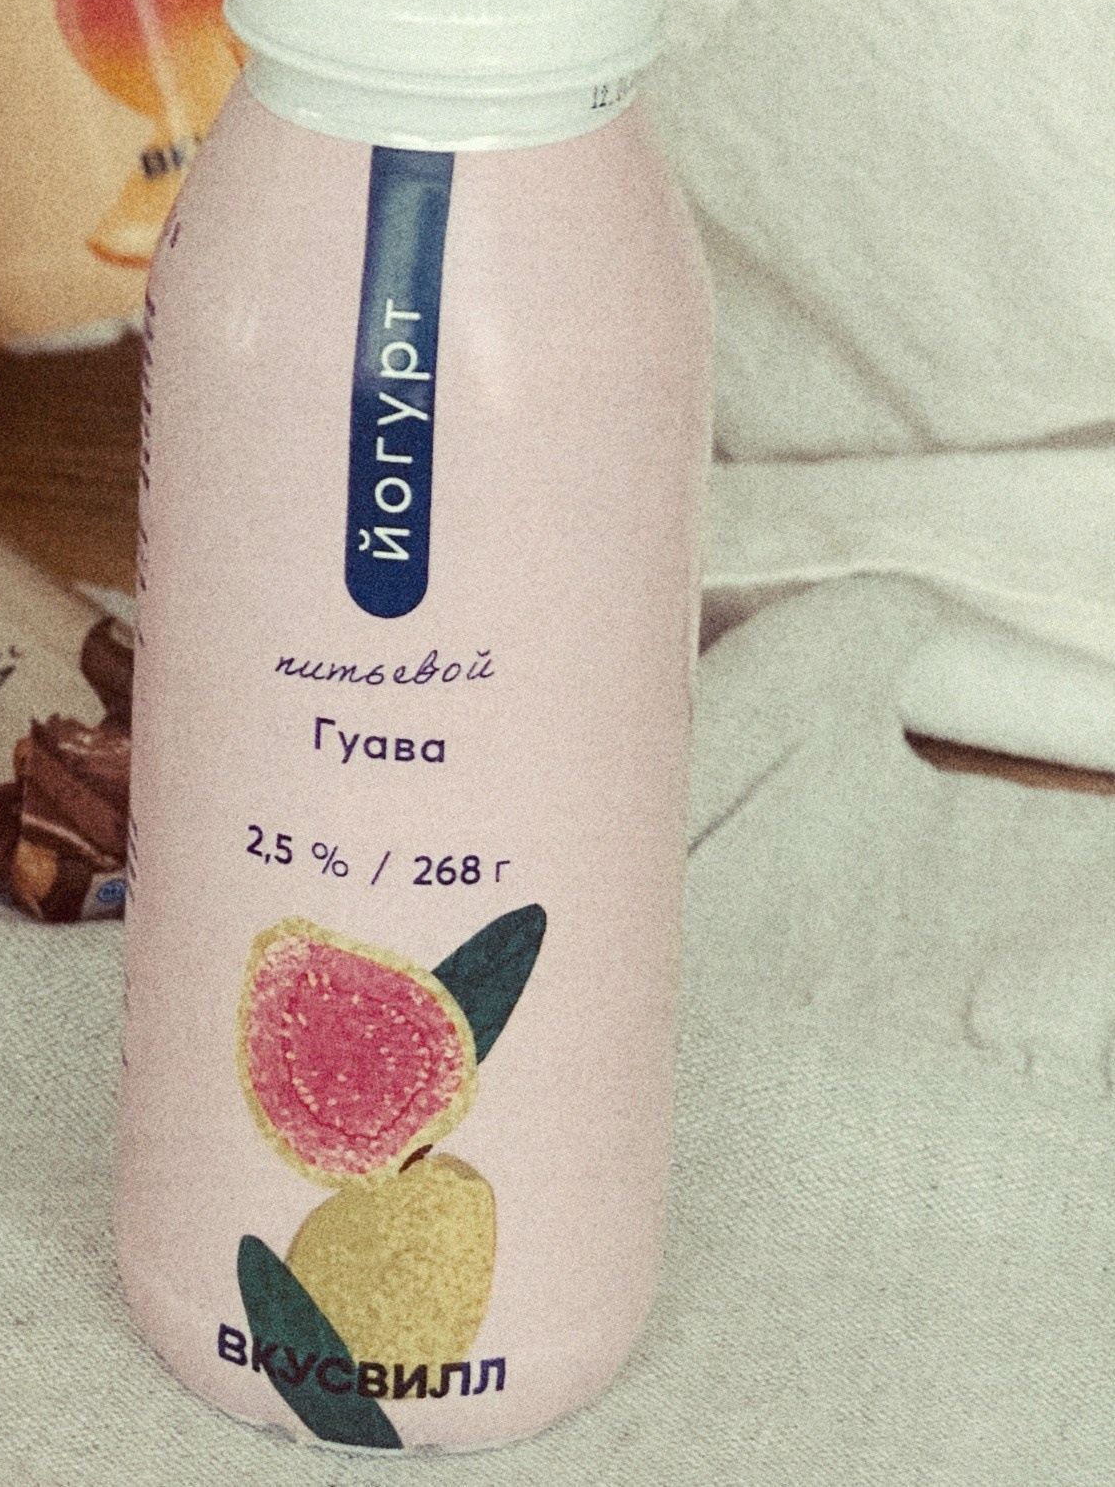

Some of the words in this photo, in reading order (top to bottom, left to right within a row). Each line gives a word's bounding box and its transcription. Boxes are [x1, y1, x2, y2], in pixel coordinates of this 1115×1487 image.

[358, 298, 431, 561] йогурт
[276, 650, 497, 686] питьевой
[313, 717, 447, 765] Гуава
[245, 824, 294, 866] 2,5
[311, 841, 350, 879] %
[370, 851, 390, 885] /
[413, 854, 481, 887] 268
[495, 858, 511, 884] г
[216, 1322, 508, 1400] ВКУСВИЛЛ
